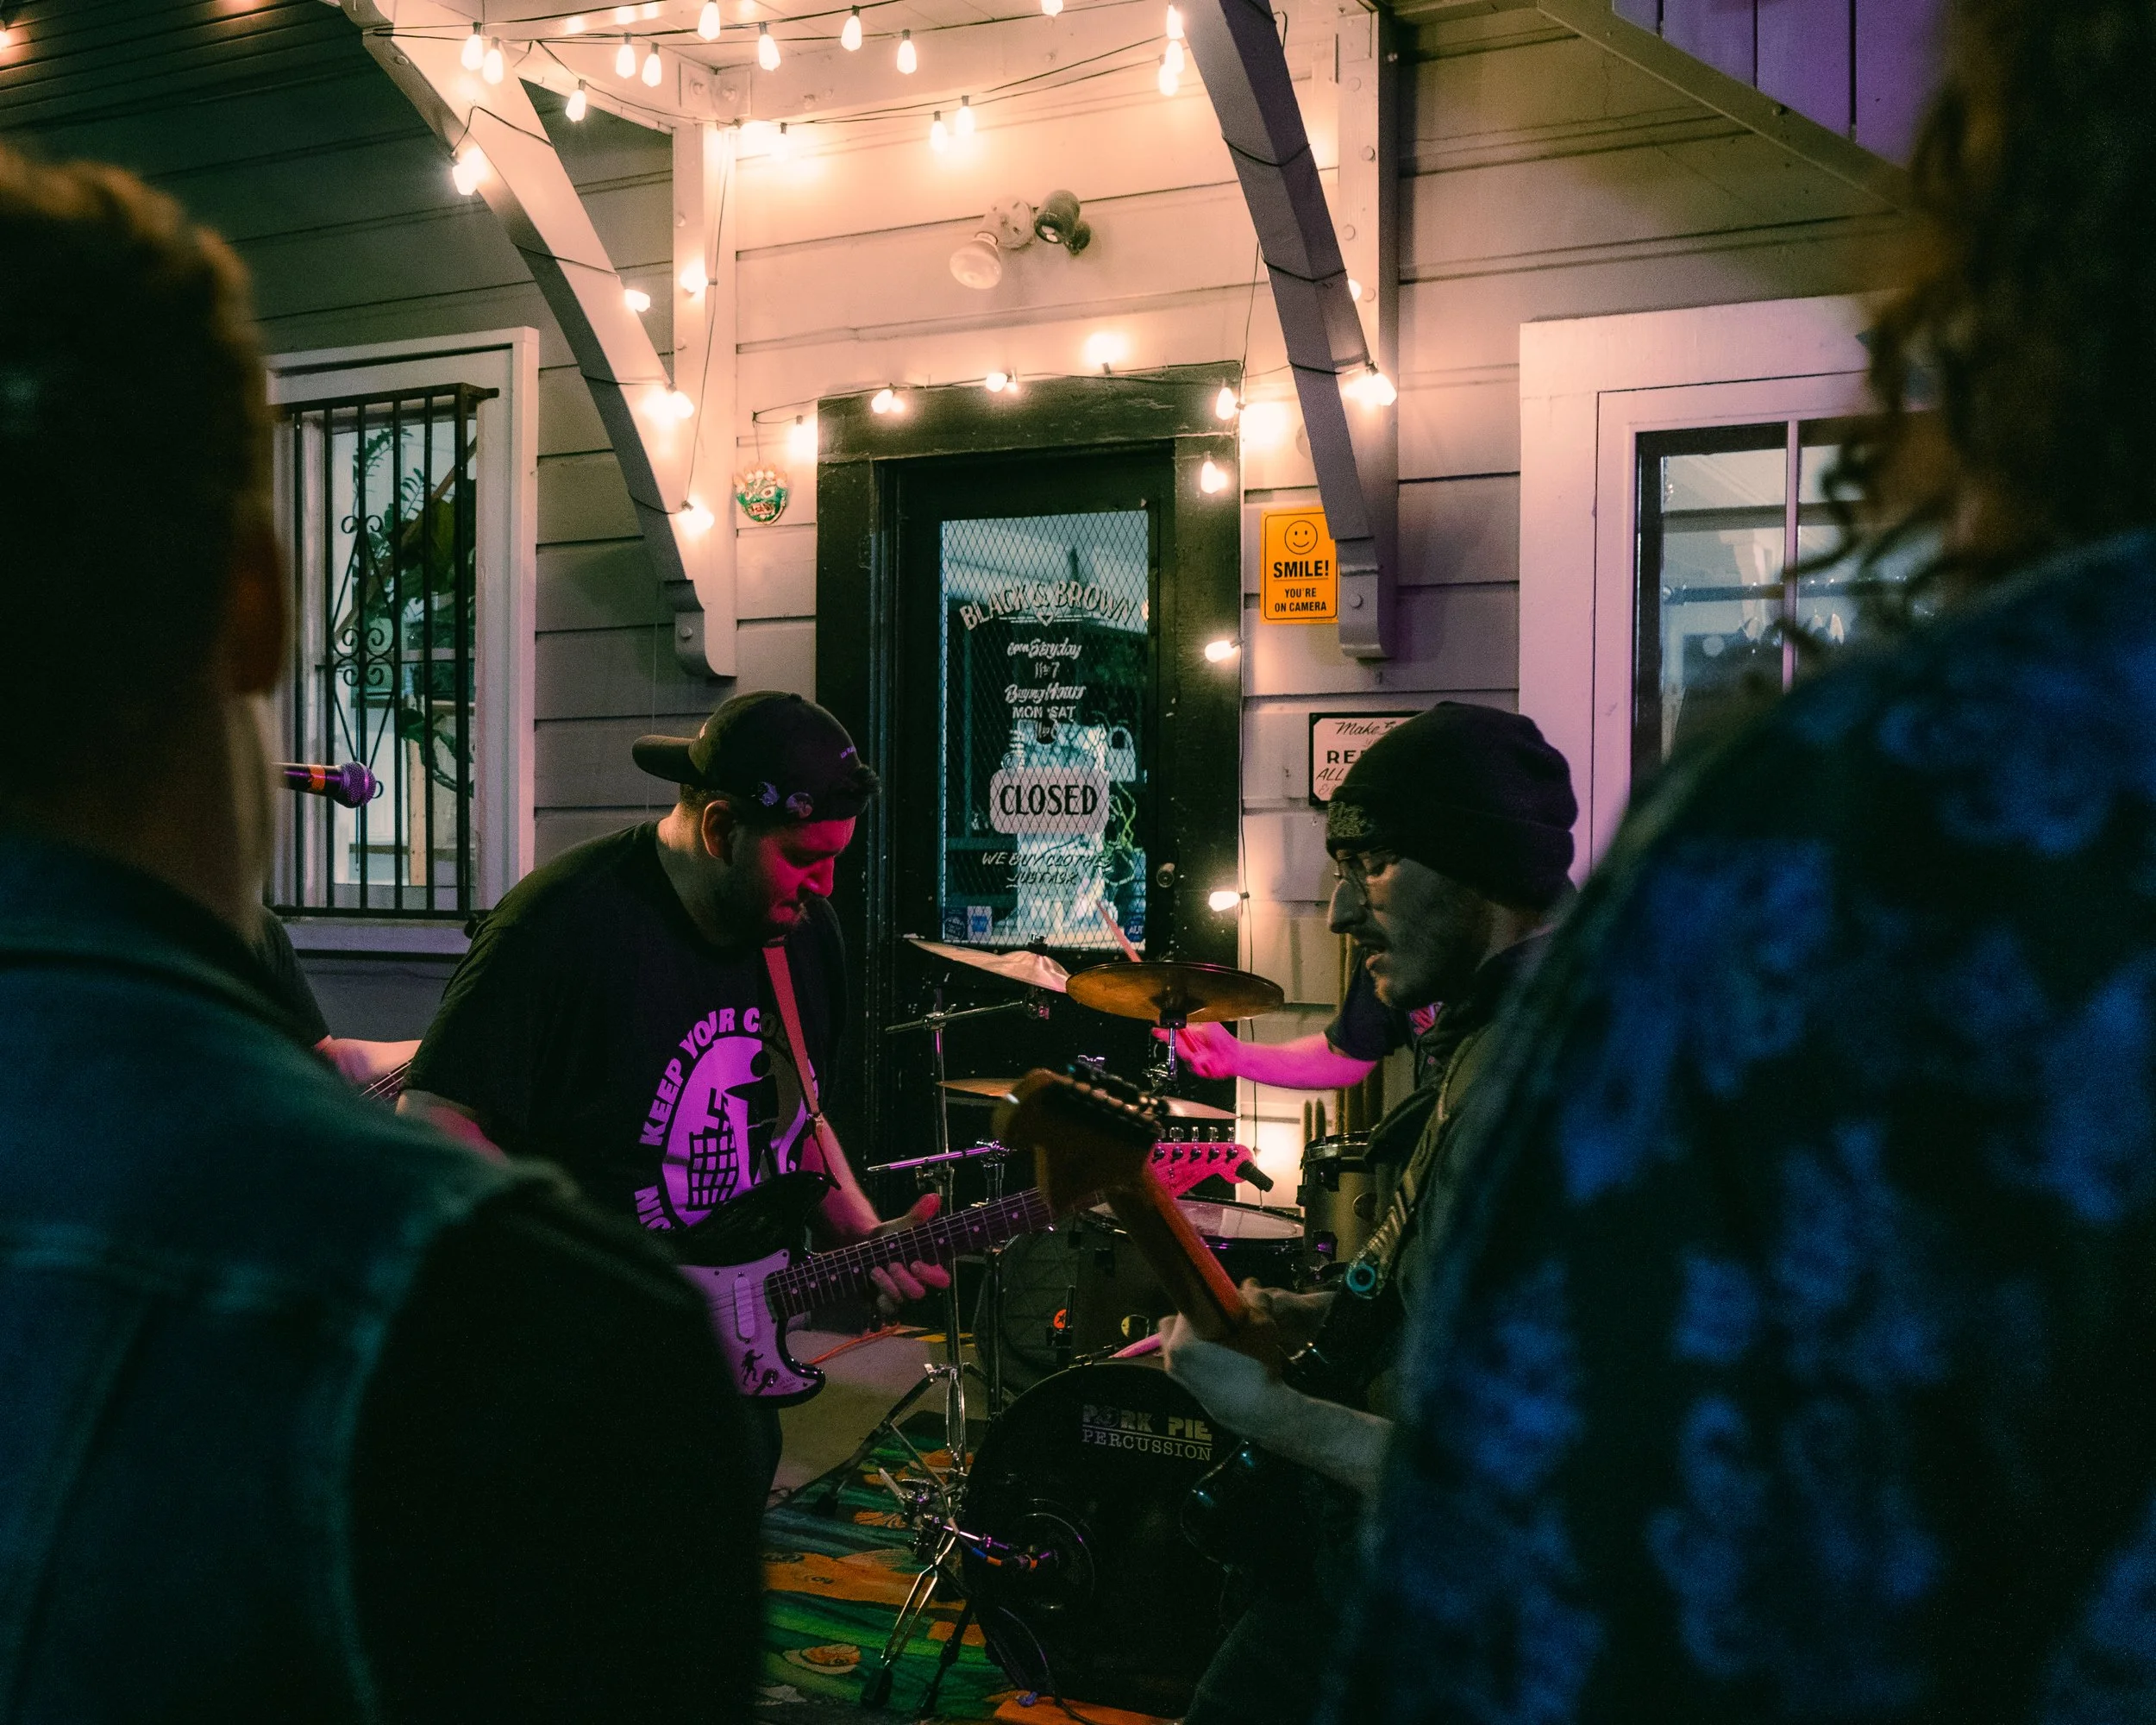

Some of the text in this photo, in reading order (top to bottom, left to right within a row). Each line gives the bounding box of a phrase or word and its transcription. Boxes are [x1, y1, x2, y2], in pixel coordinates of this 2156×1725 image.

[1273, 560, 1330, 579] SMILE!
[1284, 588, 1317, 599] YOU'RE
[960, 584, 1031, 631] BLACK
[1054, 580, 1136, 626] BROWN
[1275, 601, 1327, 612] ON CAMERA
[1012, 706, 1043, 718] MON
[1335, 721, 1381, 736] Make
[1315, 768, 1344, 781] ALL
[999, 784, 1098, 816] CLOSED
[982, 852, 1007, 866] WE
[638, 1057, 684, 1146] KEEP
[1168, 1416, 1213, 1442] PIE
[1081, 1428, 1213, 1461] PERCUSSION
